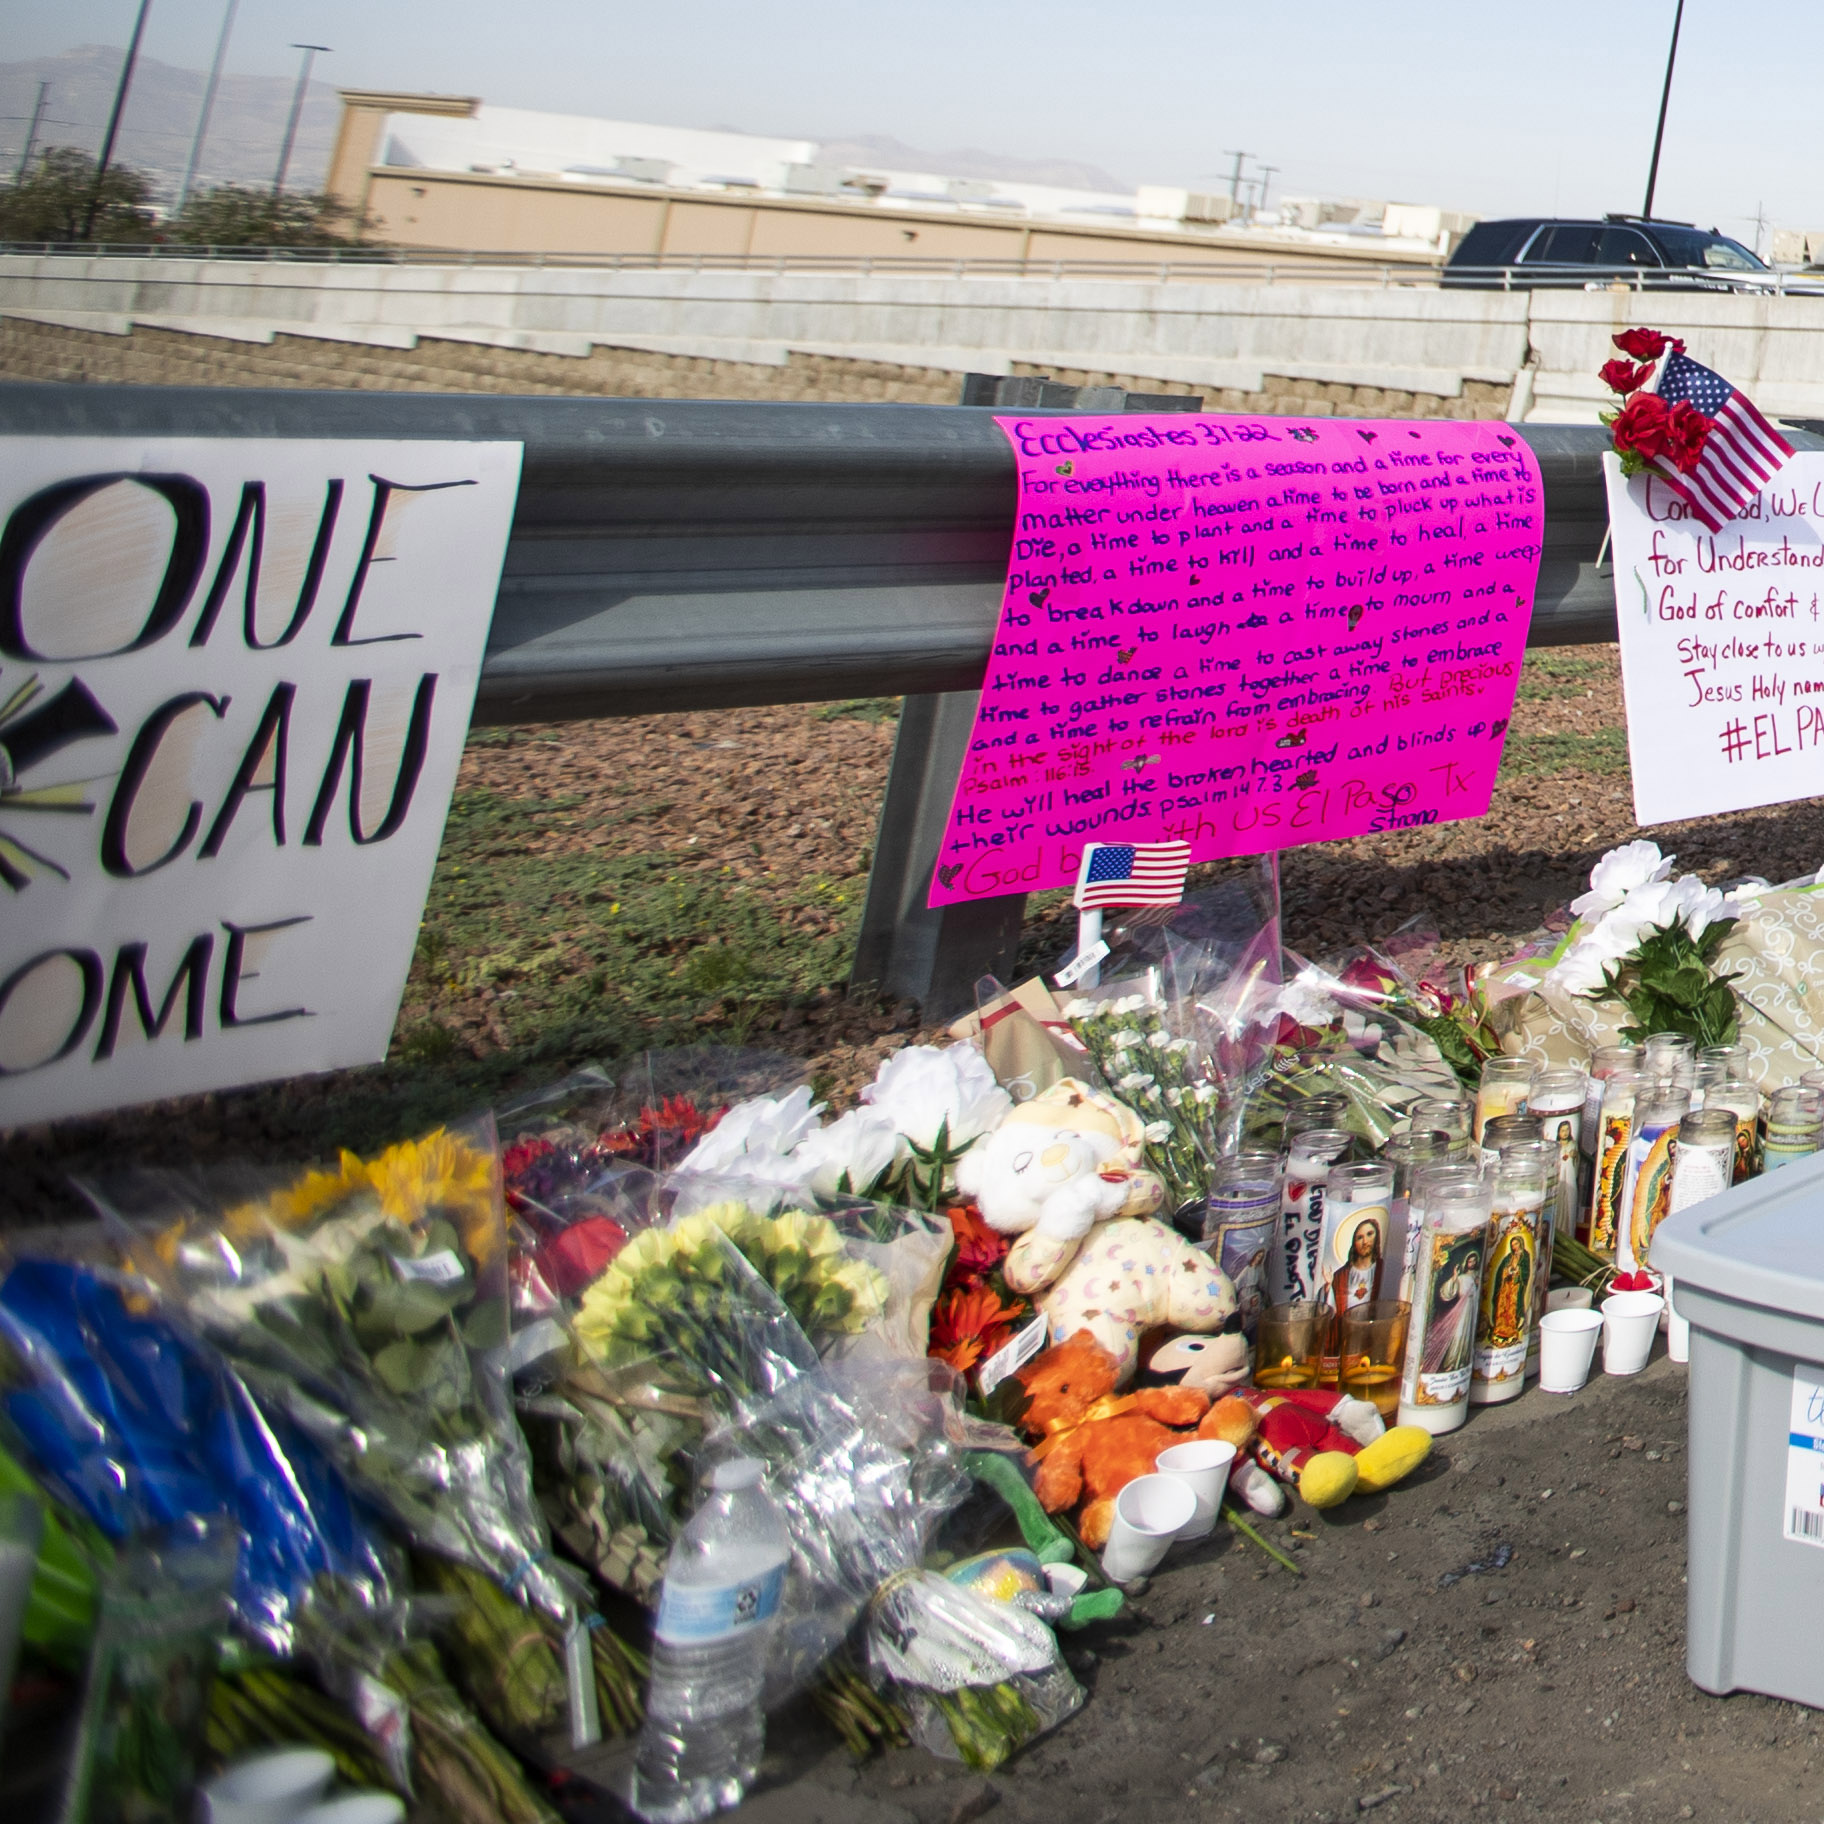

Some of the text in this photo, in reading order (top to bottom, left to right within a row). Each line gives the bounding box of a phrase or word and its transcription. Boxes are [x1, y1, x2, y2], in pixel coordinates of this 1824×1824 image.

[1022, 452, 1527, 494] For there is season and time for every
[1022, 469, 1510, 531] matter under heaven time be born and time
[1646, 475, 1691, 521] Lor
[1738, 490, 1771, 522] od,
[1091, 533, 1139, 550] time
[1178, 521, 1234, 547] plant
[1241, 517, 1274, 534] and
[1306, 507, 1348, 523] time
[1384, 498, 1432, 521] pluck
[1440, 499, 1458, 513] up
[1517, 488, 1534, 503] is
[1129, 555, 1178, 576] time
[1268, 542, 1302, 561] and
[1333, 533, 1378, 551] time
[1496, 512, 1532, 530] time
[0, 471, 480, 662] ONE
[1187, 592, 1224, 608] and
[1252, 579, 1295, 598] time
[1336, 565, 1387, 587] build
[1443, 552, 1484, 568] time
[1496, 545, 1541, 563] weep
[1648, 530, 1687, 577] for
[995, 639, 1038, 656] and
[1071, 629, 1121, 650] time
[1172, 621, 1230, 645] laugh
[1305, 602, 1348, 619] time
[1463, 581, 1496, 598] and
[1659, 585, 1696, 621] God
[1705, 590, 1727, 620] of
[1733, 586, 1799, 619] comfort
[992, 671, 1051, 692] time
[1200, 657, 1240, 673] time
[1283, 645, 1327, 665] cast
[1333, 636, 1383, 659] away
[1456, 609, 1490, 629] and
[1677, 635, 1717, 670] Stay
[1722, 636, 1759, 659] close
[1763, 632, 1782, 657] to
[1788, 642, 1806, 657] us
[972, 731, 1017, 751] and
[1050, 722, 1098, 739] time
[1226, 700, 1270, 718] from
[1389, 667, 1432, 692] But
[980, 706, 1029, 722] time
[1156, 683, 1226, 703] stones
[1238, 670, 1320, 699] together
[1349, 660, 1390, 677] time
[1684, 668, 1742, 707] Jesus
[1752, 673, 1785, 705] Holy
[1009, 752, 1048, 768] the
[1058, 739, 1117, 770] sight
[1121, 735, 1146, 750] of
[1158, 731, 1197, 745] the
[1257, 718, 1277, 732] is
[1287, 706, 1340, 727] death
[1350, 701, 1375, 718] of
[1384, 694, 1411, 711] his
[101, 673, 439, 879] CAN
[957, 805, 992, 826] He
[1001, 792, 1052, 819] will
[1064, 780, 1110, 806] heal
[1122, 778, 1158, 796] the
[1168, 765, 1248, 790] broken
[1251, 740, 1338, 774] hearted
[1347, 736, 1388, 760] and
[1397, 724, 1456, 751] blinds
[949, 823, 1034, 853] their
[964, 846, 1042, 894] God
[1341, 780, 1418, 818] Paso
[0, 916, 316, 1075] OME
